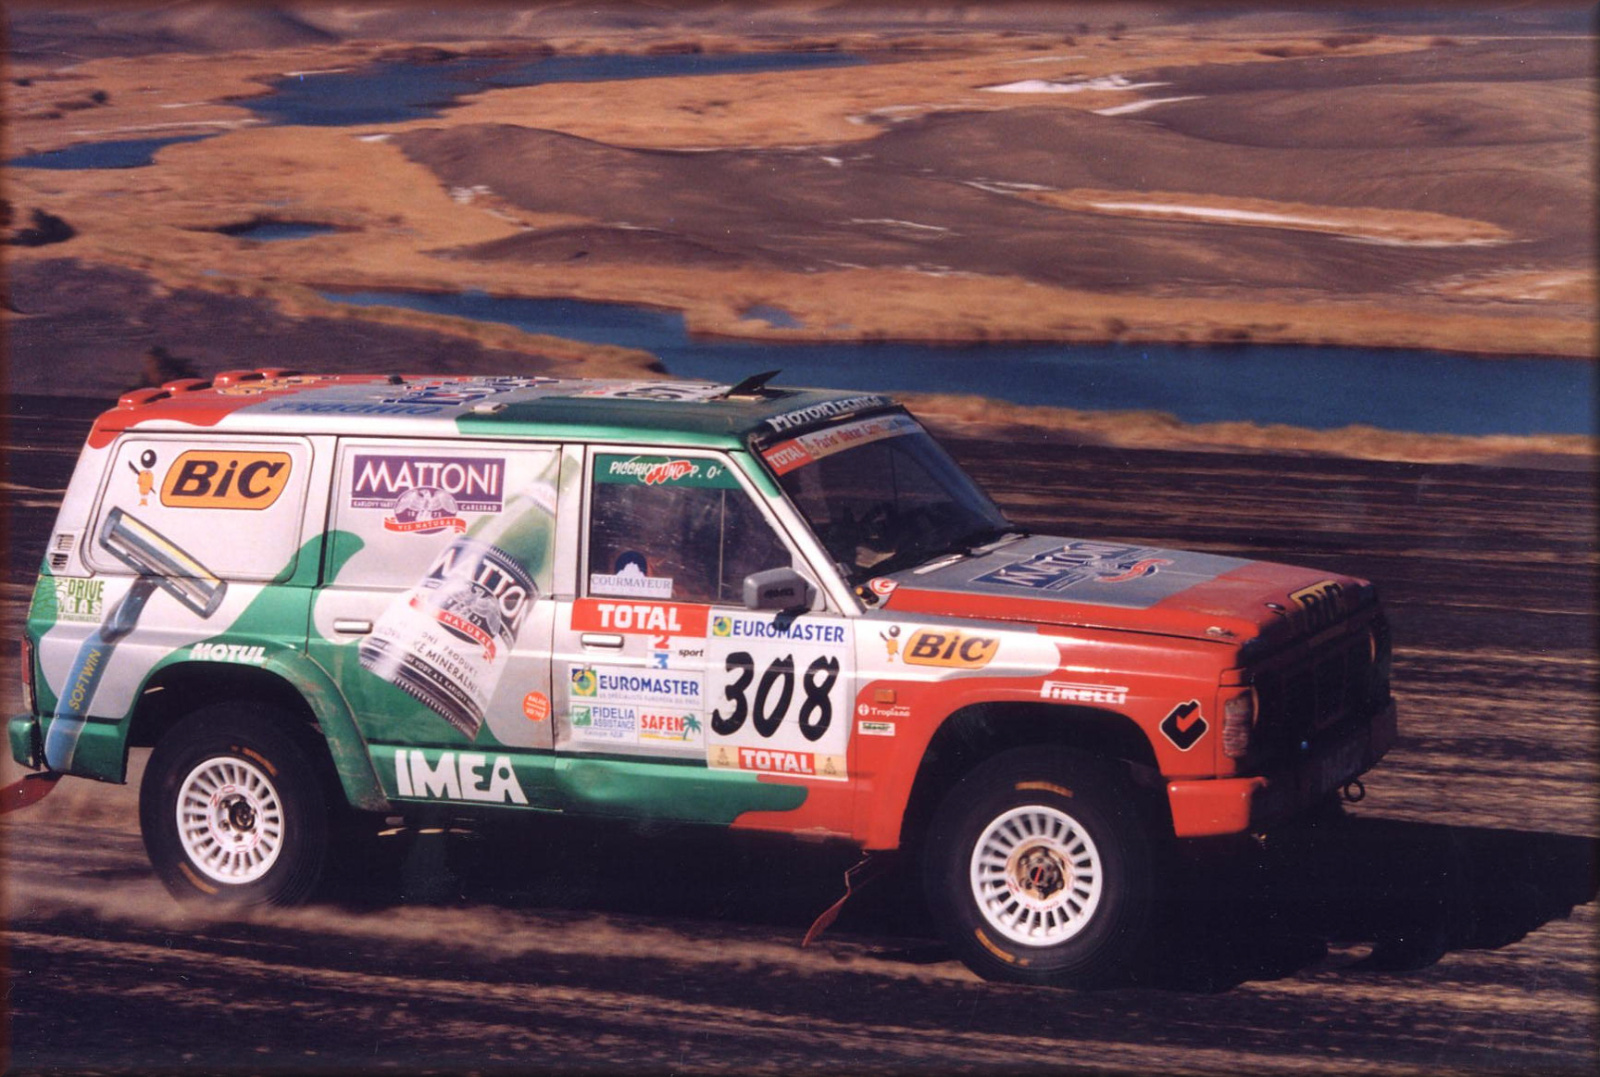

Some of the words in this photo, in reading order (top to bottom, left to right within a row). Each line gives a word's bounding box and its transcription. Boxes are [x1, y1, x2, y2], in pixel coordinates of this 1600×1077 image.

[766, 446, 807, 468] TOTAL
[355, 460, 499, 496] MATTONI
[591, 576, 671, 589] COURMAYEUR
[598, 603, 682, 631] TOTAL
[189, 643, 268, 664] MOTUL
[679, 649, 704, 657] sport
[68, 648, 101, 711] SOFTWIN
[599, 675, 699, 696] EUROMASTER
[711, 651, 840, 742] 308
[1040, 680, 1129, 705] PIRELLI
[592, 706, 636, 720] FIDELIA
[641, 714, 684, 732] SAFEN
[741, 749, 813, 773] TOTAL
[395, 749, 529, 805] IMEA
